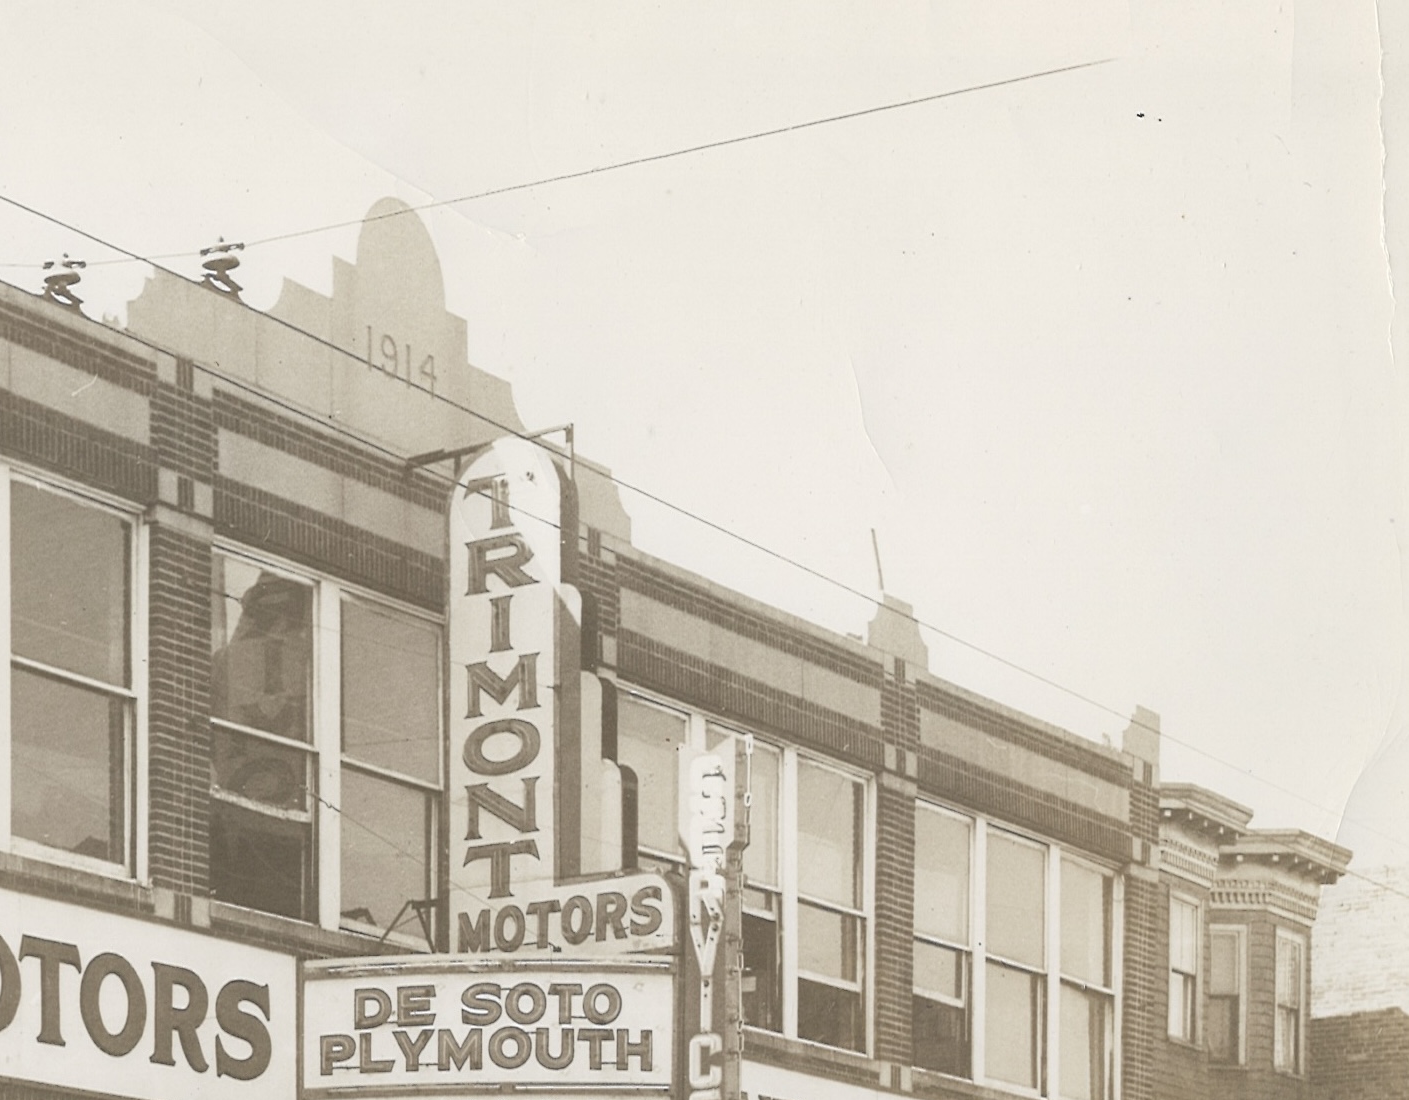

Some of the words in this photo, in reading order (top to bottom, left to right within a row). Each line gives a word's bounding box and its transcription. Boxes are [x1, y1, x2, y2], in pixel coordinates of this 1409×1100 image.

[365, 325, 437, 399] 1914
[462, 472, 541, 899] TRIMONT
[457, 884, 664, 953] MOTORS
[353, 984, 437, 1030] DE
[461, 982, 623, 1026] SOTO
[319, 1027, 654, 1076] PLYMOUTH
